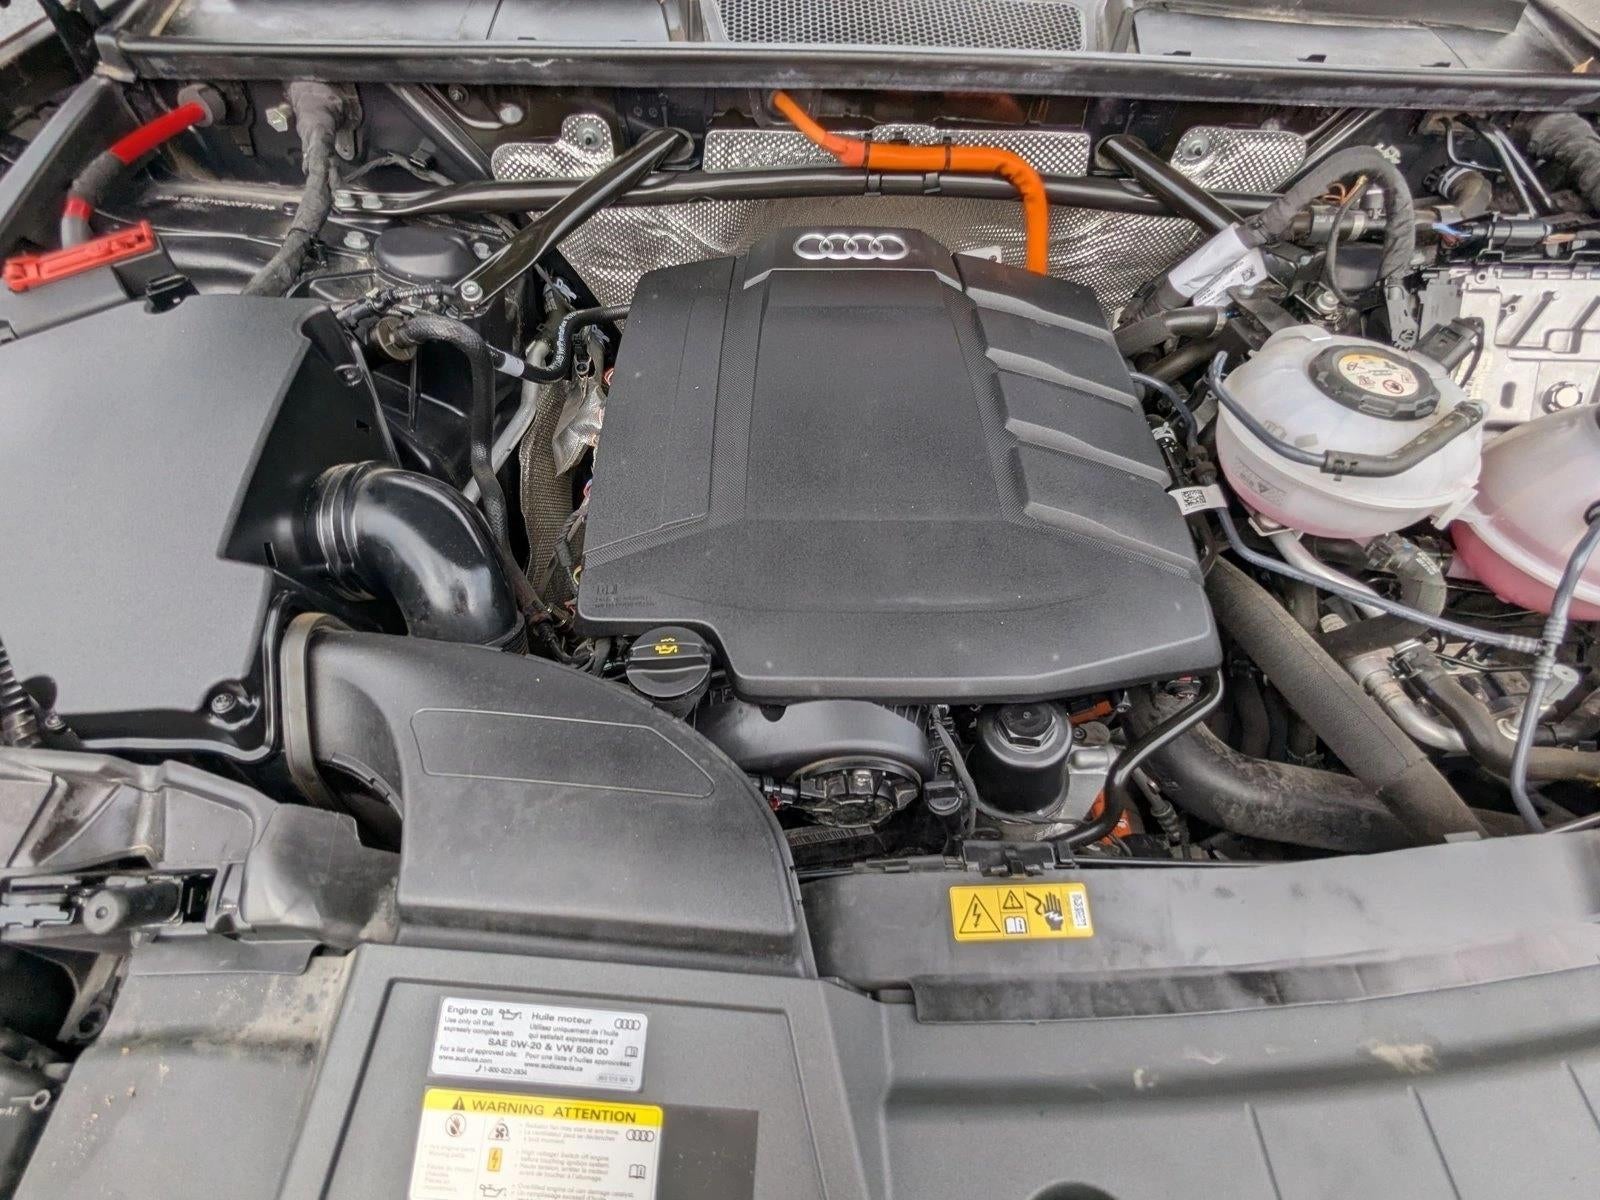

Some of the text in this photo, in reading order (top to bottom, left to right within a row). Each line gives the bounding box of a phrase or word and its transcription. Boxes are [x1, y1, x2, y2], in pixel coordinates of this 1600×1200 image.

[447, 1005, 493, 1016] Engine Oil
[458, 1017, 471, 1025] only
[531, 1012, 592, 1025] Huile moteur
[501, 1029, 514, 1037] with
[475, 1048, 504, 1057] approved
[488, 1038, 508, 1047] SAE
[510, 1040, 542, 1050] 0W-20
[544, 1043, 552, 1051] &
[556, 1044, 574, 1053] VW
[596, 1047, 609, 1056] 00
[472, 1100, 636, 1123] WARNING ATTENTION
